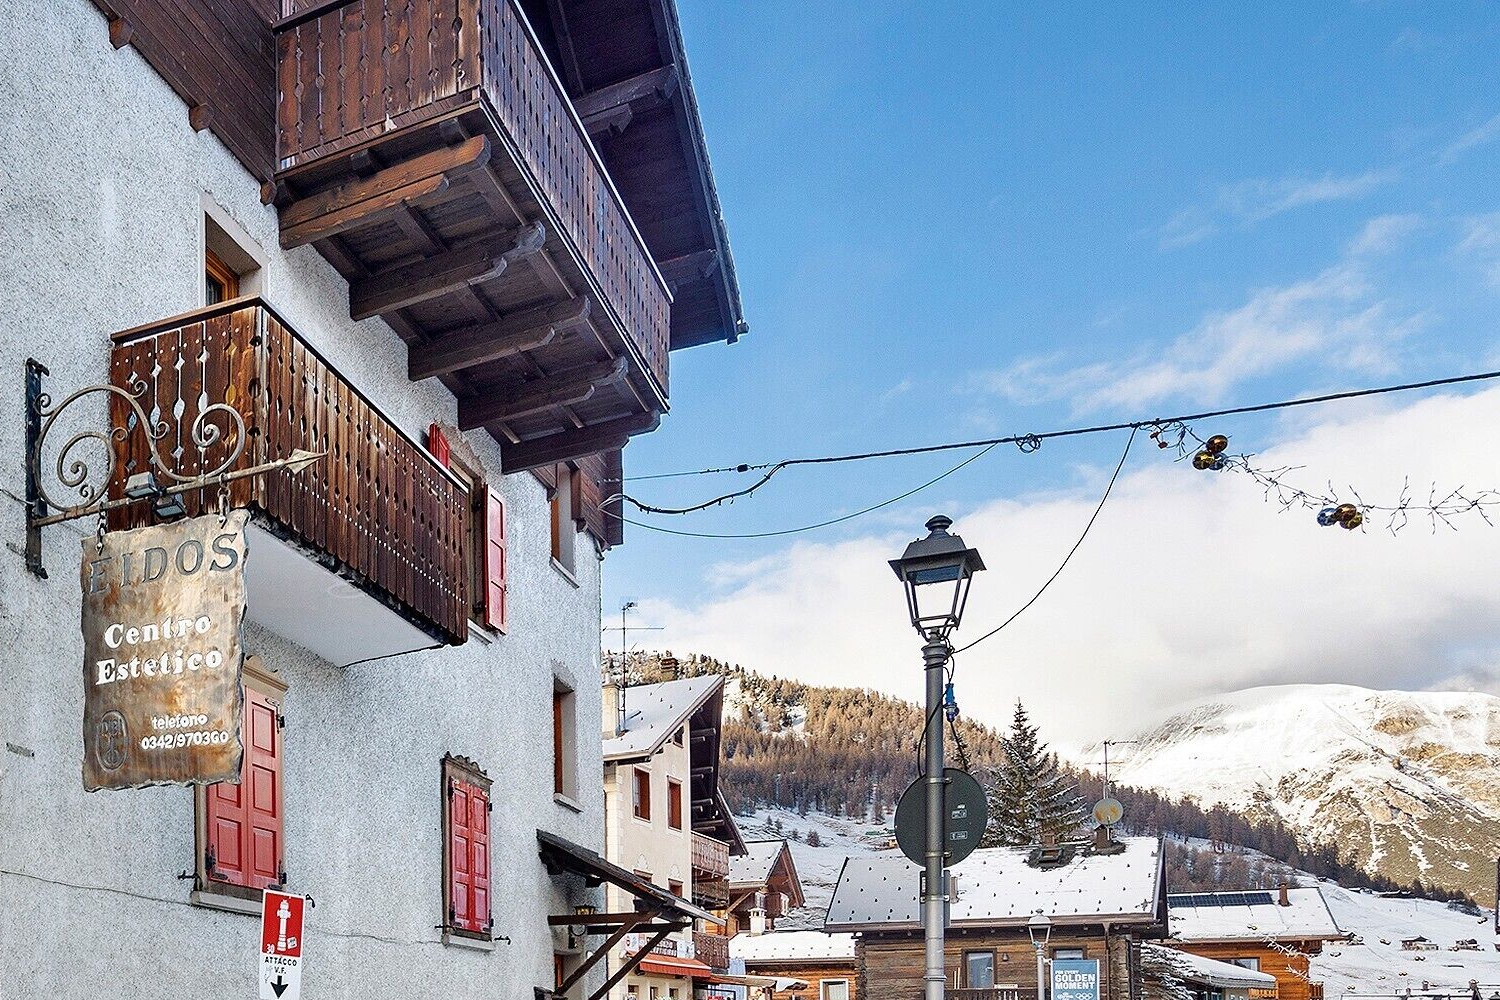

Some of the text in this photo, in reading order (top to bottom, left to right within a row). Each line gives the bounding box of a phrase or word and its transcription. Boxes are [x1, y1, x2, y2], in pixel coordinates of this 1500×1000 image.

[88, 532, 239, 594] EIDOS
[104, 614, 213, 649] Centro
[95, 648, 223, 686] Estetico
[152, 713, 208, 730] telefono
[141, 730, 229, 750] 0342/970360
[264, 957, 297, 966] ATTACCO
[274, 966, 286, 974] V.F.
[1055, 974, 1095, 982] GOLDEN
